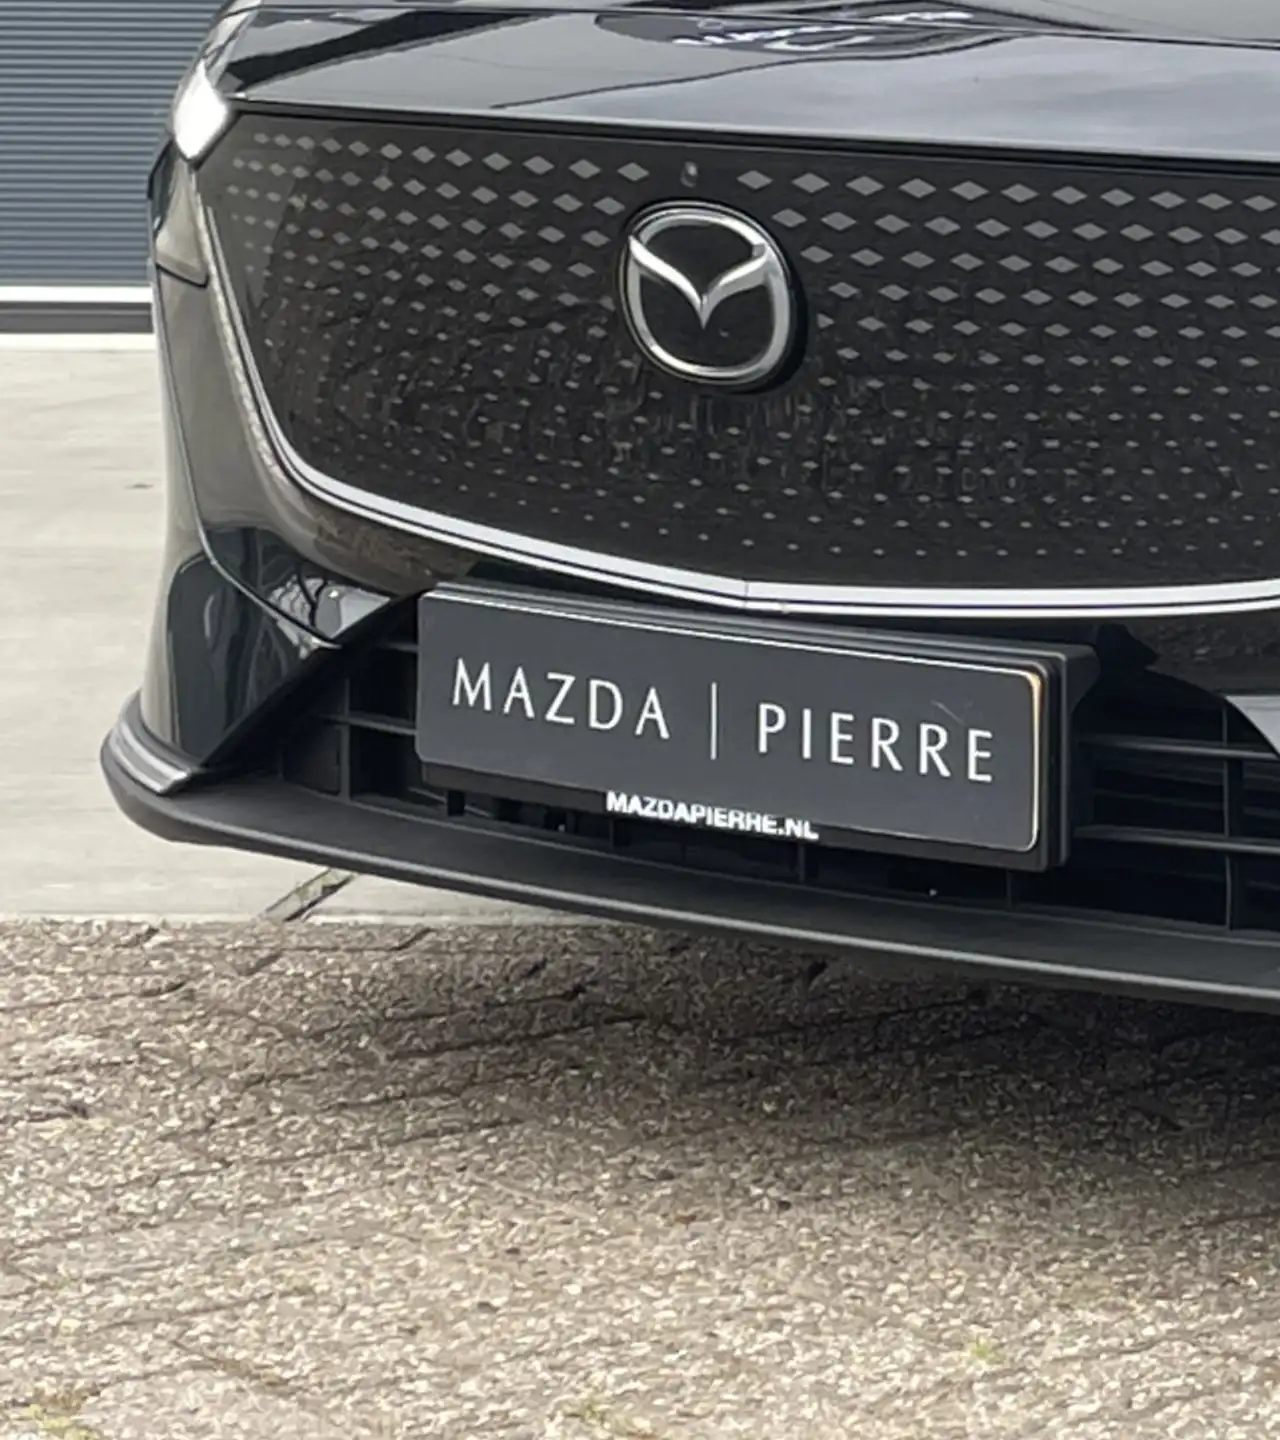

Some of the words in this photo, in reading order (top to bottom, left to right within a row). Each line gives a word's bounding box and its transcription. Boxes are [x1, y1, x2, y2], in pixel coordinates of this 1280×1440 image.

[452, 656, 670, 740] MAZDA
[757, 702, 994, 783] PIERRE
[606, 790, 819, 840] MAZDAPIERRE.NL
